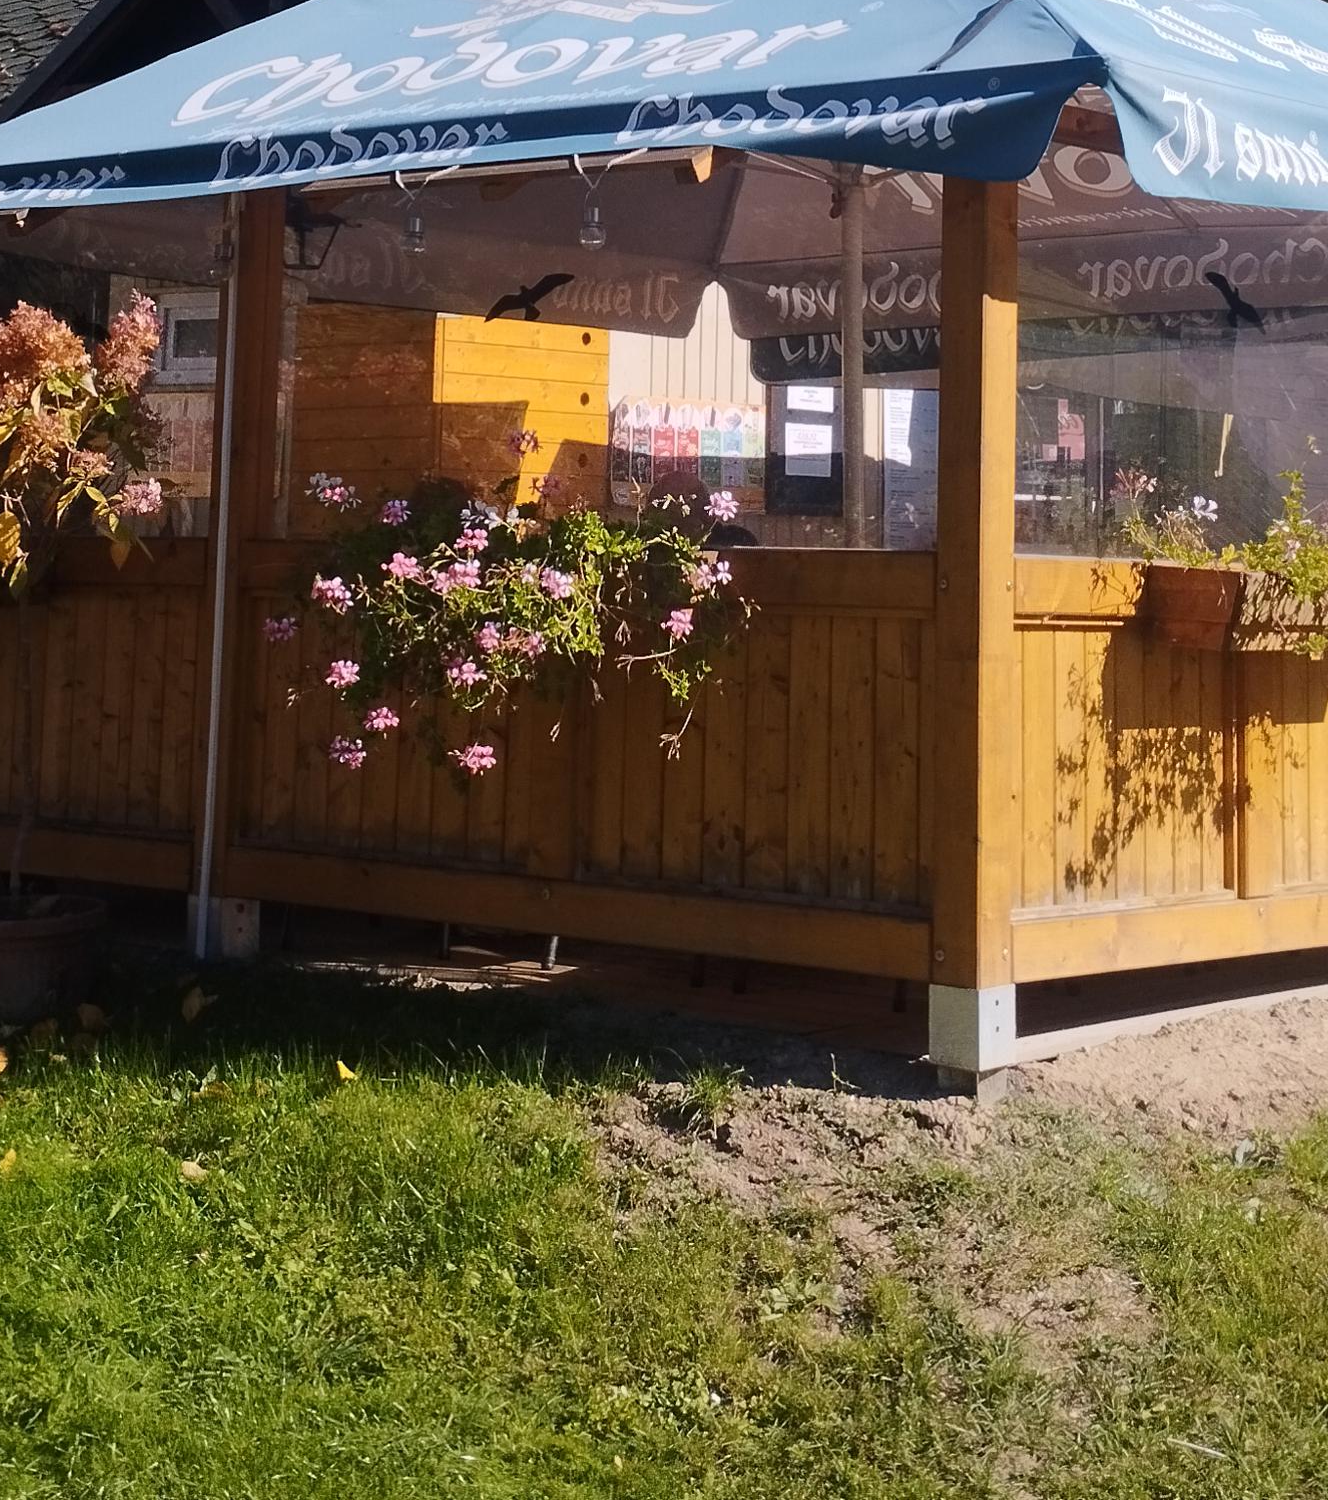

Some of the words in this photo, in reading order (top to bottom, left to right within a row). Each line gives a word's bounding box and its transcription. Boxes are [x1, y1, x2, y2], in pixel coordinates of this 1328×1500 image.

[171, 19, 849, 126] Chodovar
[615, 84, 988, 150] Chodovar
[209, 121, 509, 189] Chodovar
